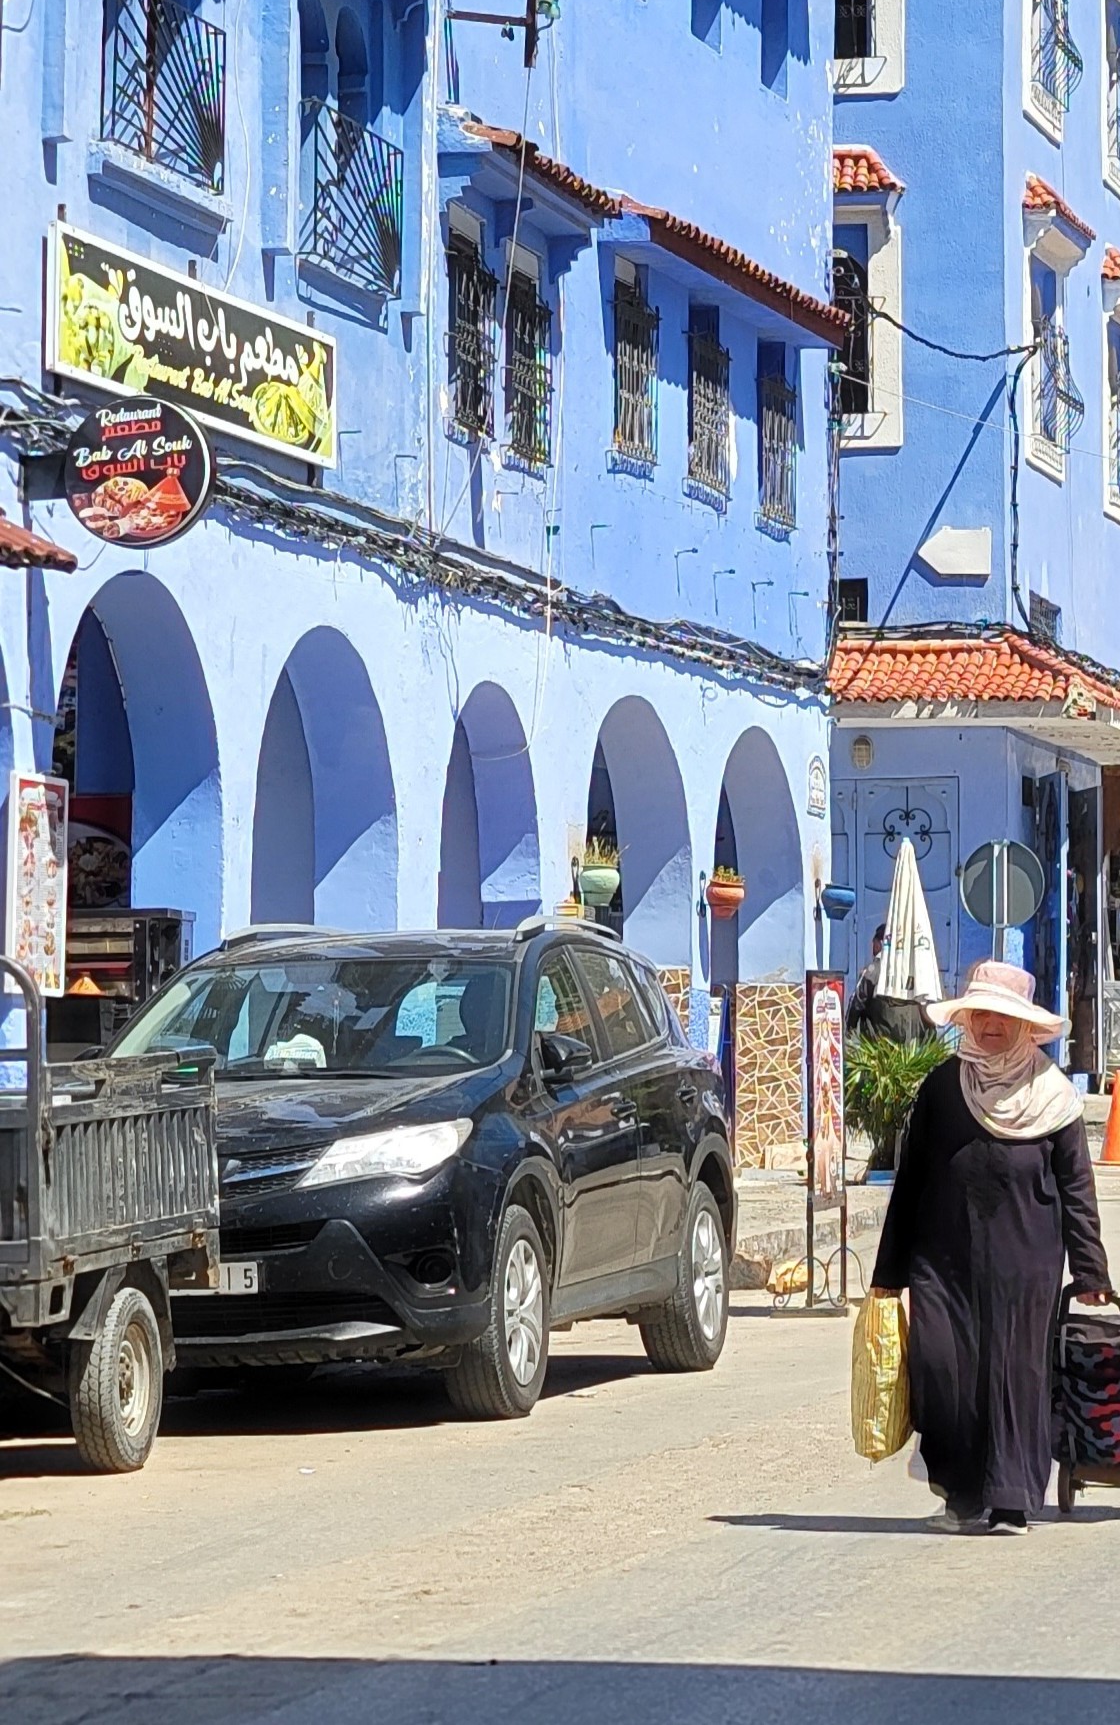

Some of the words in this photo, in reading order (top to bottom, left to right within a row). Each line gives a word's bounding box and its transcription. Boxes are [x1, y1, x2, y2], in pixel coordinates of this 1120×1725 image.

[118, 268, 196, 351] السوق
[196, 307, 237, 374] باب
[239, 327, 300, 386] مطعم
[132, 345, 190, 389] Restaurant
[191, 367, 215, 398] Bab
[214, 377, 232, 404] Al
[95, 403, 162, 427] Restaurant
[102, 420, 161, 441] مطعم
[73, 445, 113, 467] Bab
[117, 439, 148, 461] Al
[152, 435, 192, 455] Souk
[150, 454, 186, 471] باب
[82, 458, 145, 480] السوق
